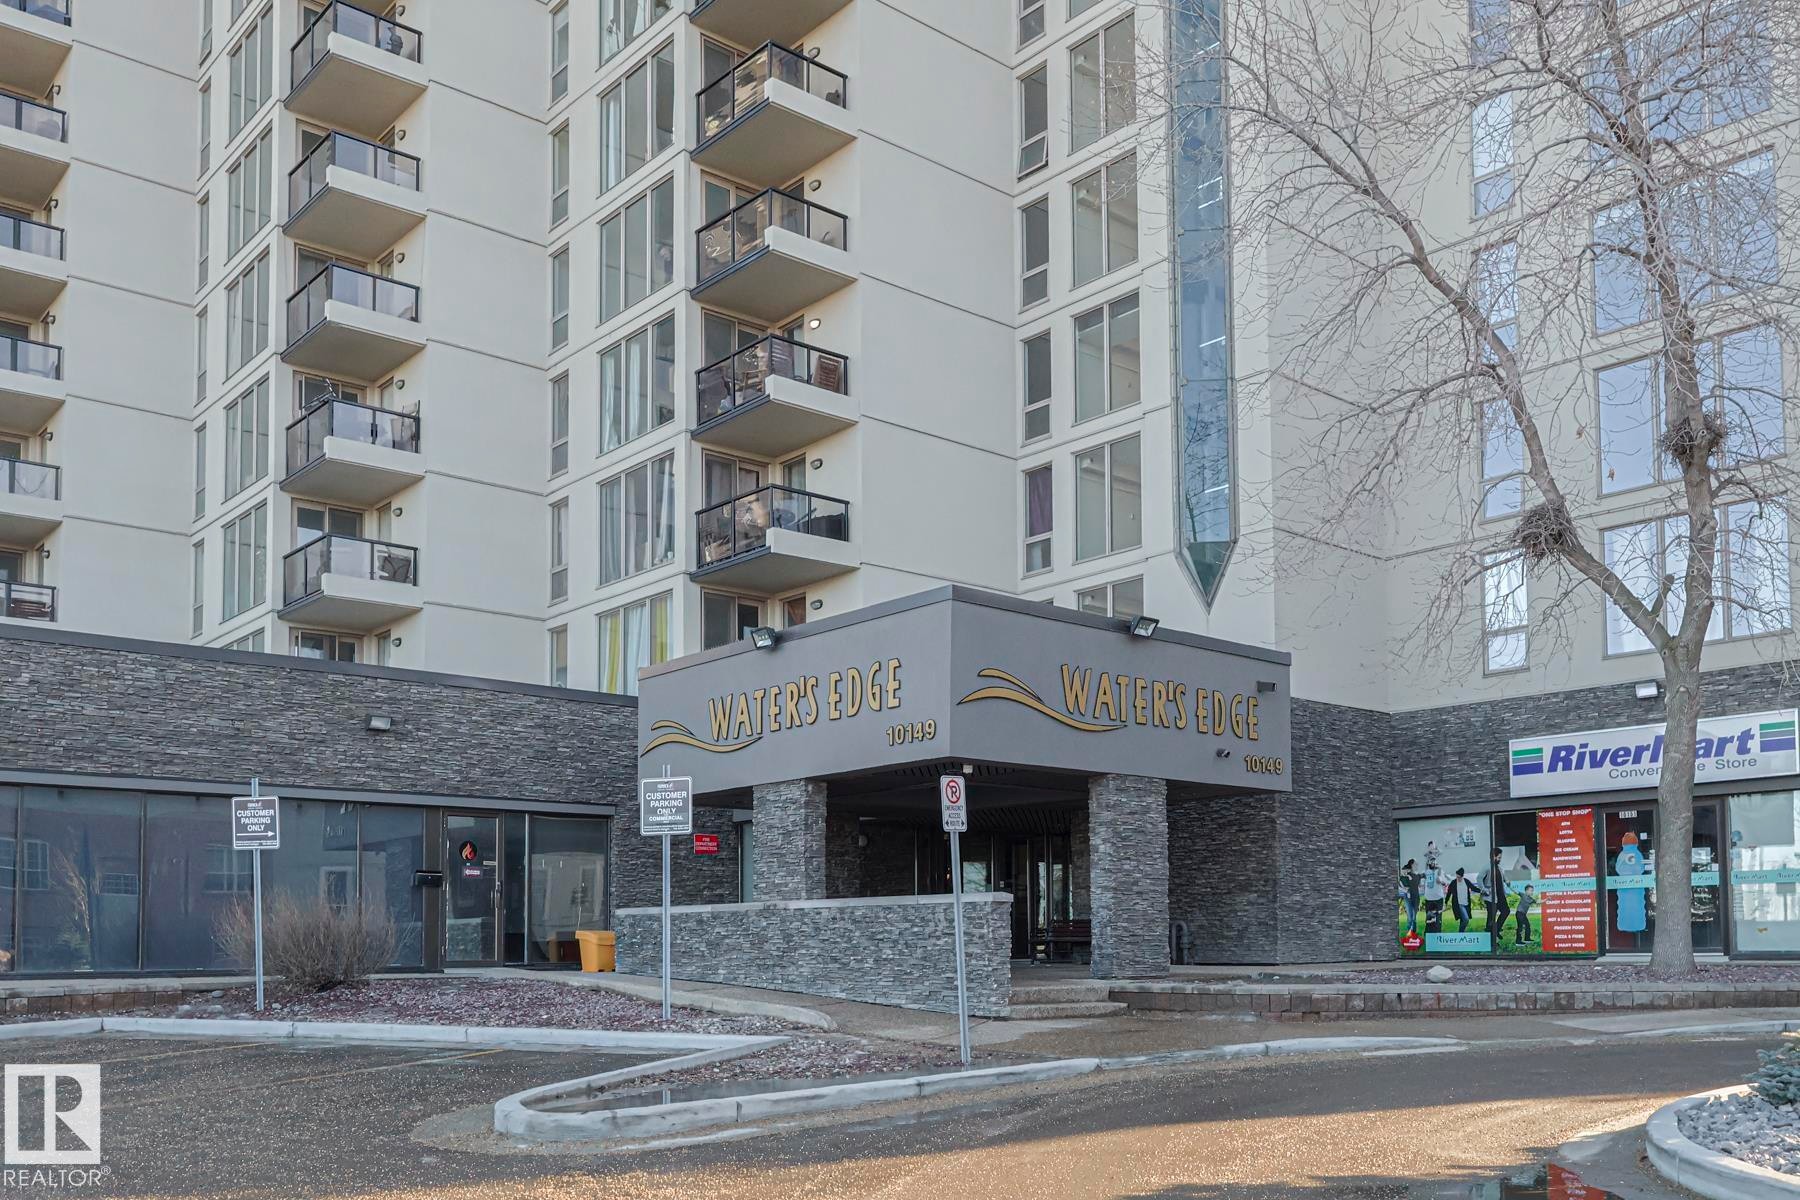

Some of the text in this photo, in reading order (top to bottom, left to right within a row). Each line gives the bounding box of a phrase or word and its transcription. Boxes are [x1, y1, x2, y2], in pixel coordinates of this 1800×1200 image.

[708, 658, 901, 742] WATER'S EDGE
[1061, 664, 1259, 741] WATER'S EDGE
[886, 719, 936, 746] 10149
[1245, 755, 1284, 775] 10149
[1715, 757, 1757, 770] Store
[646, 791, 687, 800] CUSTOMER
[650, 799, 683, 807] PARKING
[236, 809, 274, 817] CUSTOMER
